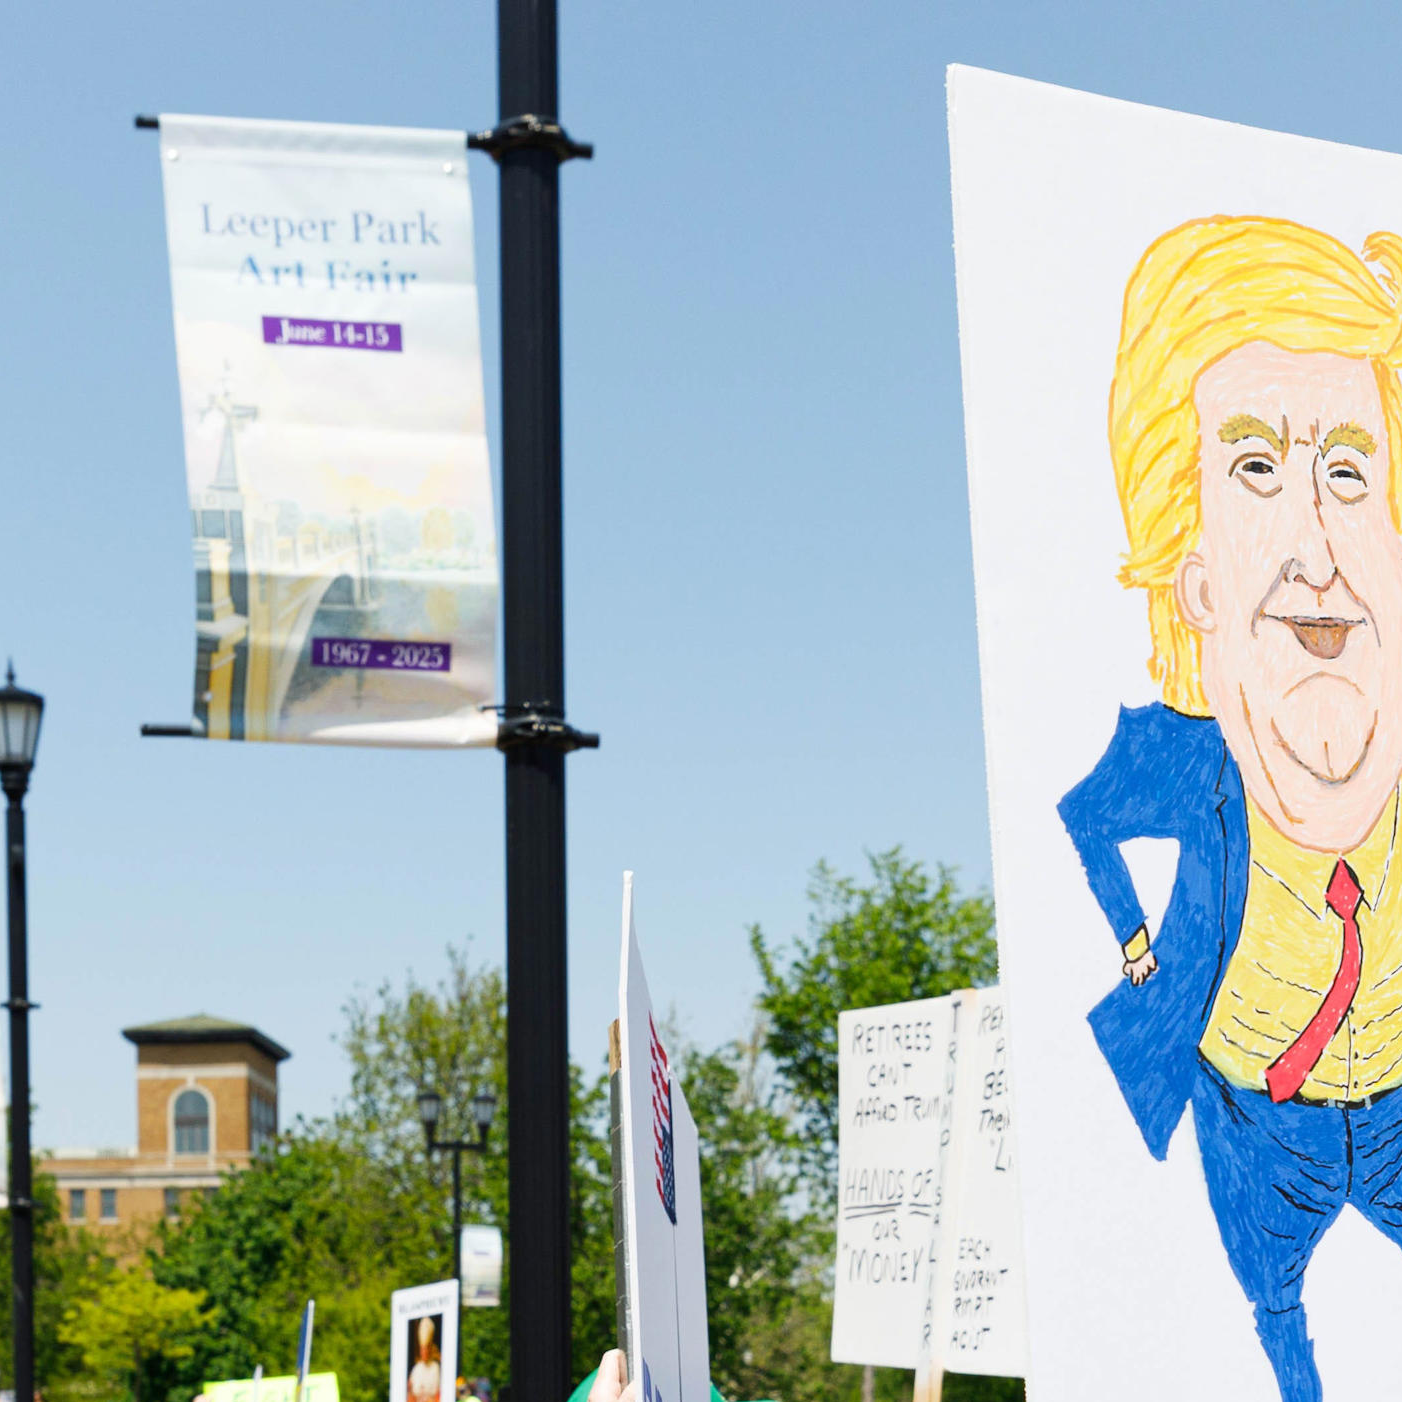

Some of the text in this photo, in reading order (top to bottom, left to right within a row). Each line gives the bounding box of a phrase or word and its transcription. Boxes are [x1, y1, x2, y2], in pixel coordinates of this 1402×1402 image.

[201, 203, 442, 248] Leeper Park
[238, 255, 418, 291] Art Fair
[275, 318, 391, 347] June 14-15
[321, 642, 372, 664] 1967
[391, 644, 445, 668] 2025
[852, 1020, 932, 1054] RETIREES
[845, 1168, 903, 1202] HANDS
